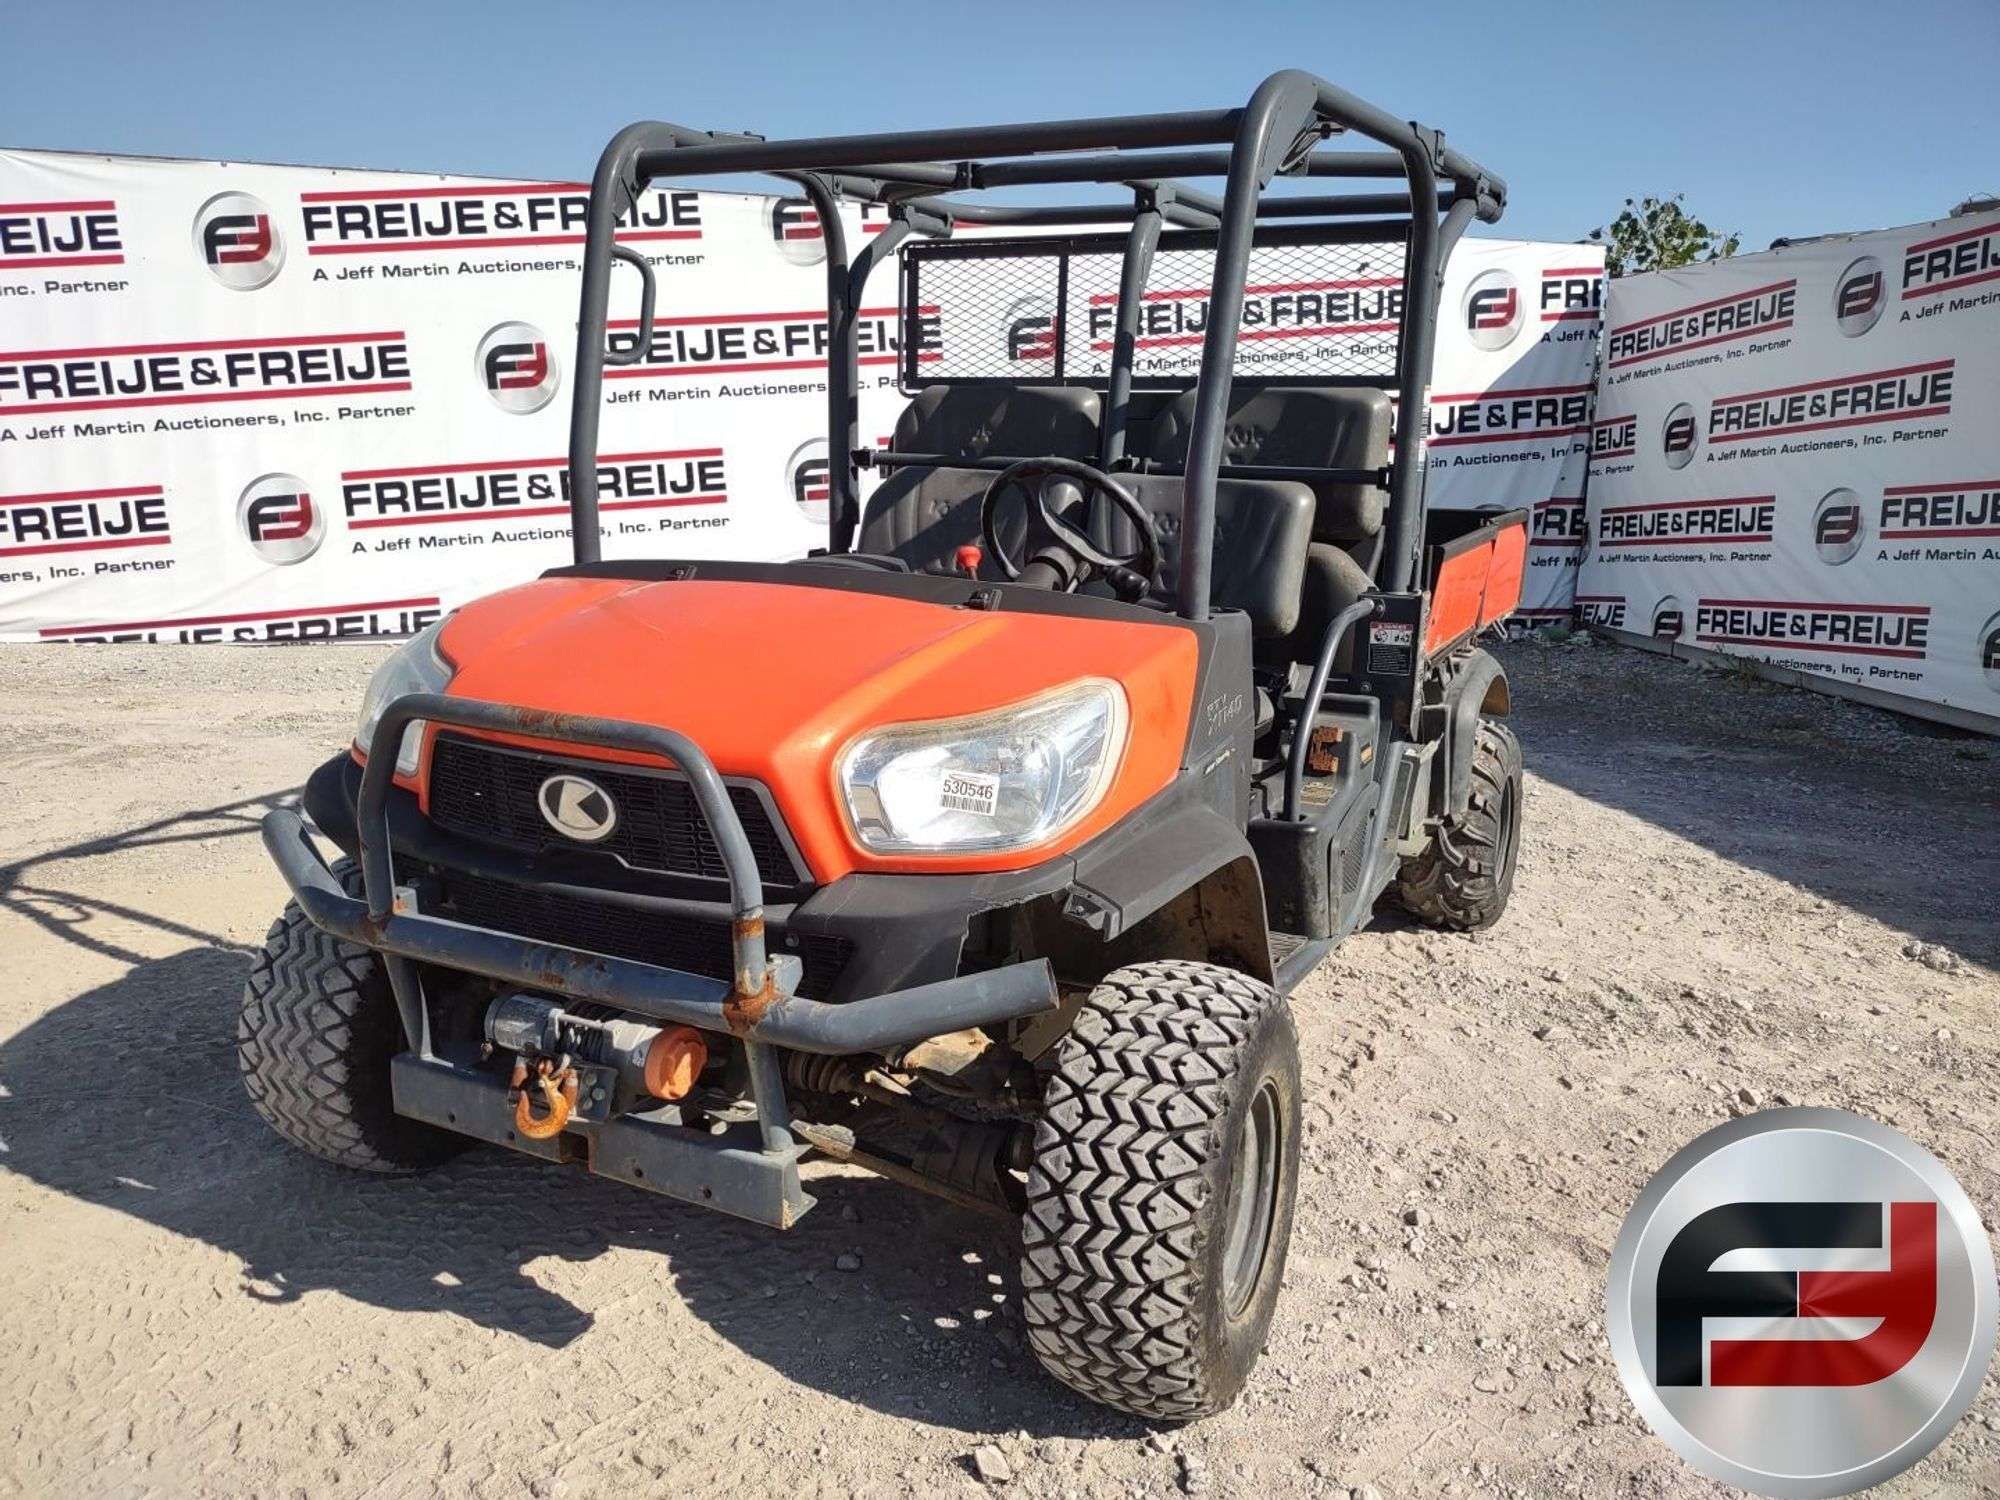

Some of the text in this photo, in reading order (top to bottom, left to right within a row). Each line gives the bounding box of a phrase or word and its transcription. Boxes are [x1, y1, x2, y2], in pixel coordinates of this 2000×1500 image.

[313, 268, 328, 281] A
[336, 265, 374, 280] Jeff
[383, 262, 449, 279] Martin
[458, 257, 582, 276] Auctioneers,
[643, 253, 704, 266] artner
[45, 279, 129, 295] Partner
[1900, 310, 1911, 322] A
[1916, 302, 1945, 319] Jeff
[1541, 332, 1551, 343] A
[1557, 329, 1585, 342] Jeff
[1664, 353, 1724, 375] Auctioneers,
[1726, 347, 1744, 360] Inc.
[1748, 338, 1792, 356] Partner
[606, 390, 642, 404] Jeff
[649, 386, 711, 402] Martin
[1, 404, 416, 442] A Jeff Martin Auctioneers, Inc. Partner
[1717, 447, 1737, 461] Jeff
[1739, 443, 1777, 458] Martin
[1780, 438, 1858, 456] Auctioneers,
[1862, 434, 1887, 447] Inc.
[1892, 426, 1948, 443] Partner
[1453, 451, 1546, 467] Auctioneers,
[352, 540, 366, 553] A
[374, 536, 410, 552] Jeff
[419, 532, 484, 548] Martin
[619, 520, 652, 533] Inc.
[659, 516, 730, 531] Partner
[1531, 555, 1560, 567] Jeff
[1652, 552, 1706, 563] Auctioneers,
[1709, 551, 1727, 562] Inc.
[1731, 551, 1772, 562] Partner
[1877, 550, 1888, 561] A
[1893, 549, 1921, 561] Jeff
[1925, 548, 1976, 561] Martin
[49, 565, 86, 579] Inc.
[95, 558, 176, 576] Partner
[1842, 662, 1864, 676] Inc.
[1869, 665, 1924, 682] Partner
[943, 779, 993, 800] 530546
